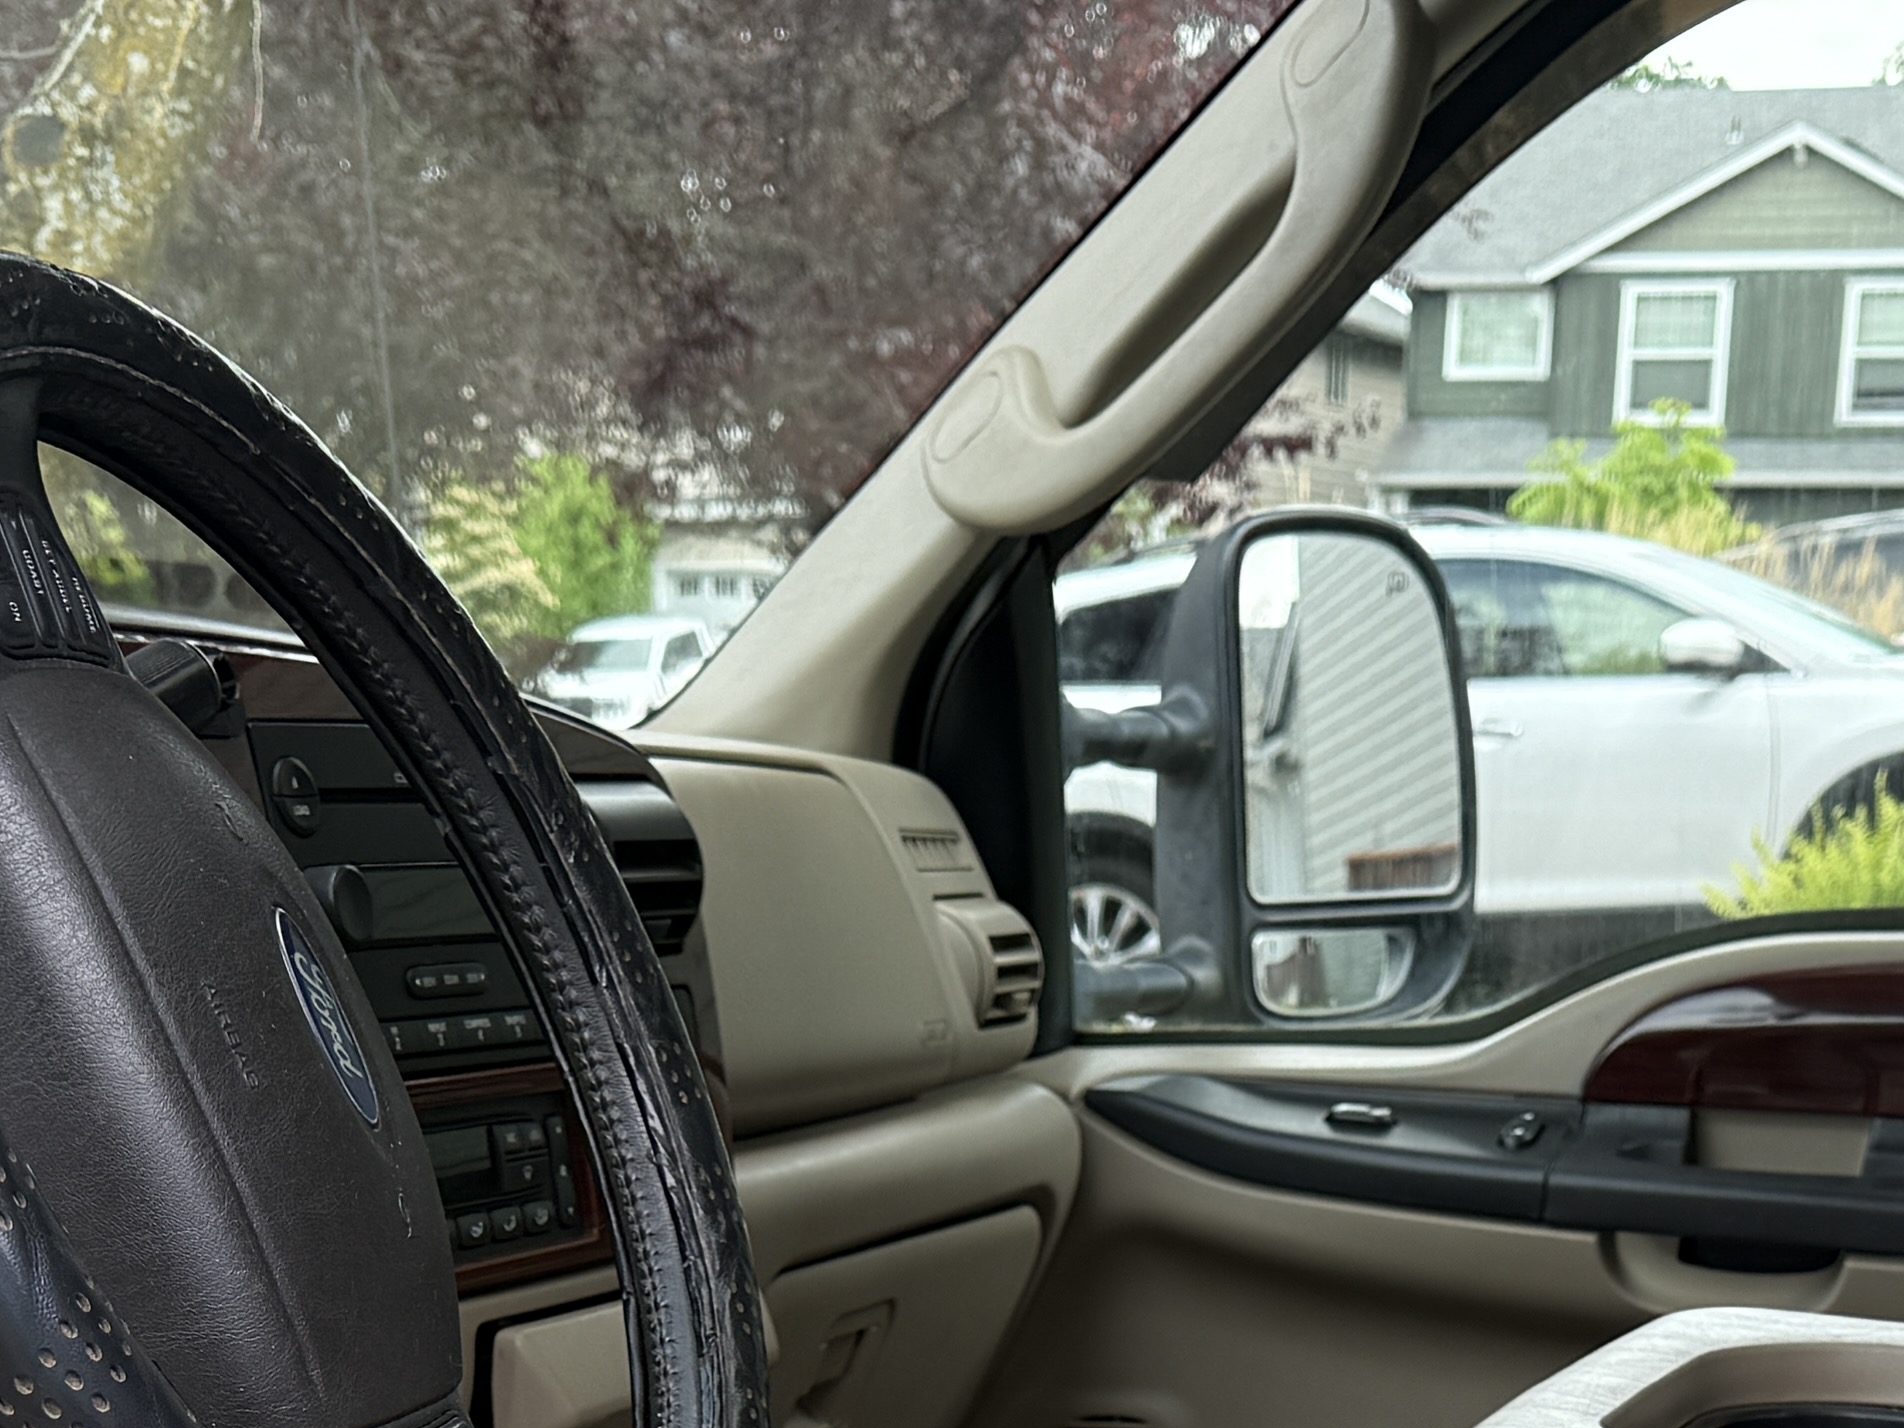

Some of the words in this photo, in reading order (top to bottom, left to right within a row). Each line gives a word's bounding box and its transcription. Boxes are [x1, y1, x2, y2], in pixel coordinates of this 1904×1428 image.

[8, 601, 23, 622] ON
[201, 977, 259, 1089] AIRBAG
[295, 952, 363, 1079] Ford
